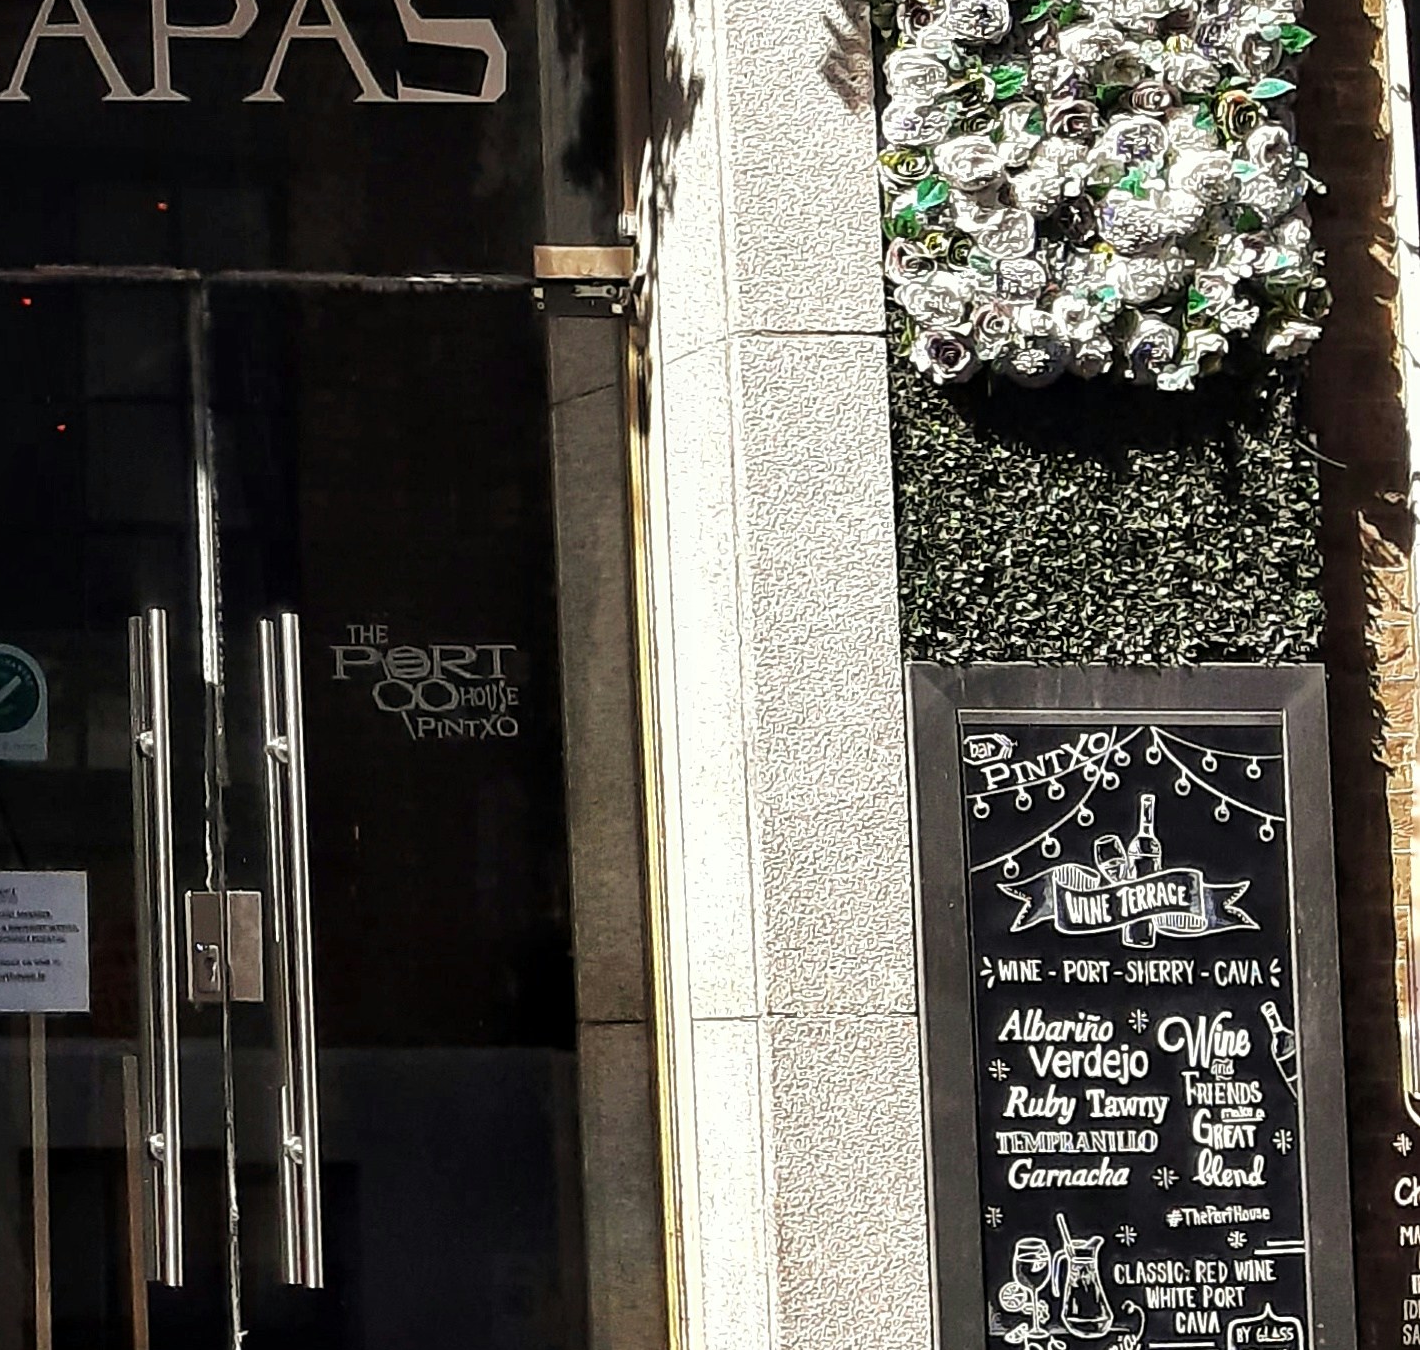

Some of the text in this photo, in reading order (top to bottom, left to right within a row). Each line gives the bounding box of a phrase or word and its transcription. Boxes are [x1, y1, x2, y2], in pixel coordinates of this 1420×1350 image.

[347, 625, 389, 644] THE
[329, 645, 517, 680] PORT
[461, 680, 519, 713] HOUSE
[417, 714, 518, 740] PINTXO
[980, 731, 1110, 791] PINTXO
[1065, 882, 1189, 926] WINE TERRACE
[997, 958, 1264, 987] WINE PORT SHERRY CAVA
[998, 1008, 1115, 1043] Albariño
[1157, 1010, 1252, 1069] Wine
[1028, 1043, 1149, 1085] Verdejo
[1211, 1059, 1235, 1078] and
[1003, 1083, 1171, 1126] Ruby Tawny
[1181, 1070, 1263, 1106] FRIENDS
[996, 1129, 1160, 1155] TEMPRANILLO
[1192, 1108, 1258, 1150] GREAT
[1008, 1156, 1131, 1190] Garnacha
[1192, 1147, 1268, 1188] blend
[1195, 1260, 1228, 1284] RED
[1234, 1259, 1277, 1283] WINE
[1145, 1286, 1246, 1310] WHITE PORT
[1175, 1311, 1222, 1335] CAVA
[1236, 1325, 1253, 1344] BY
